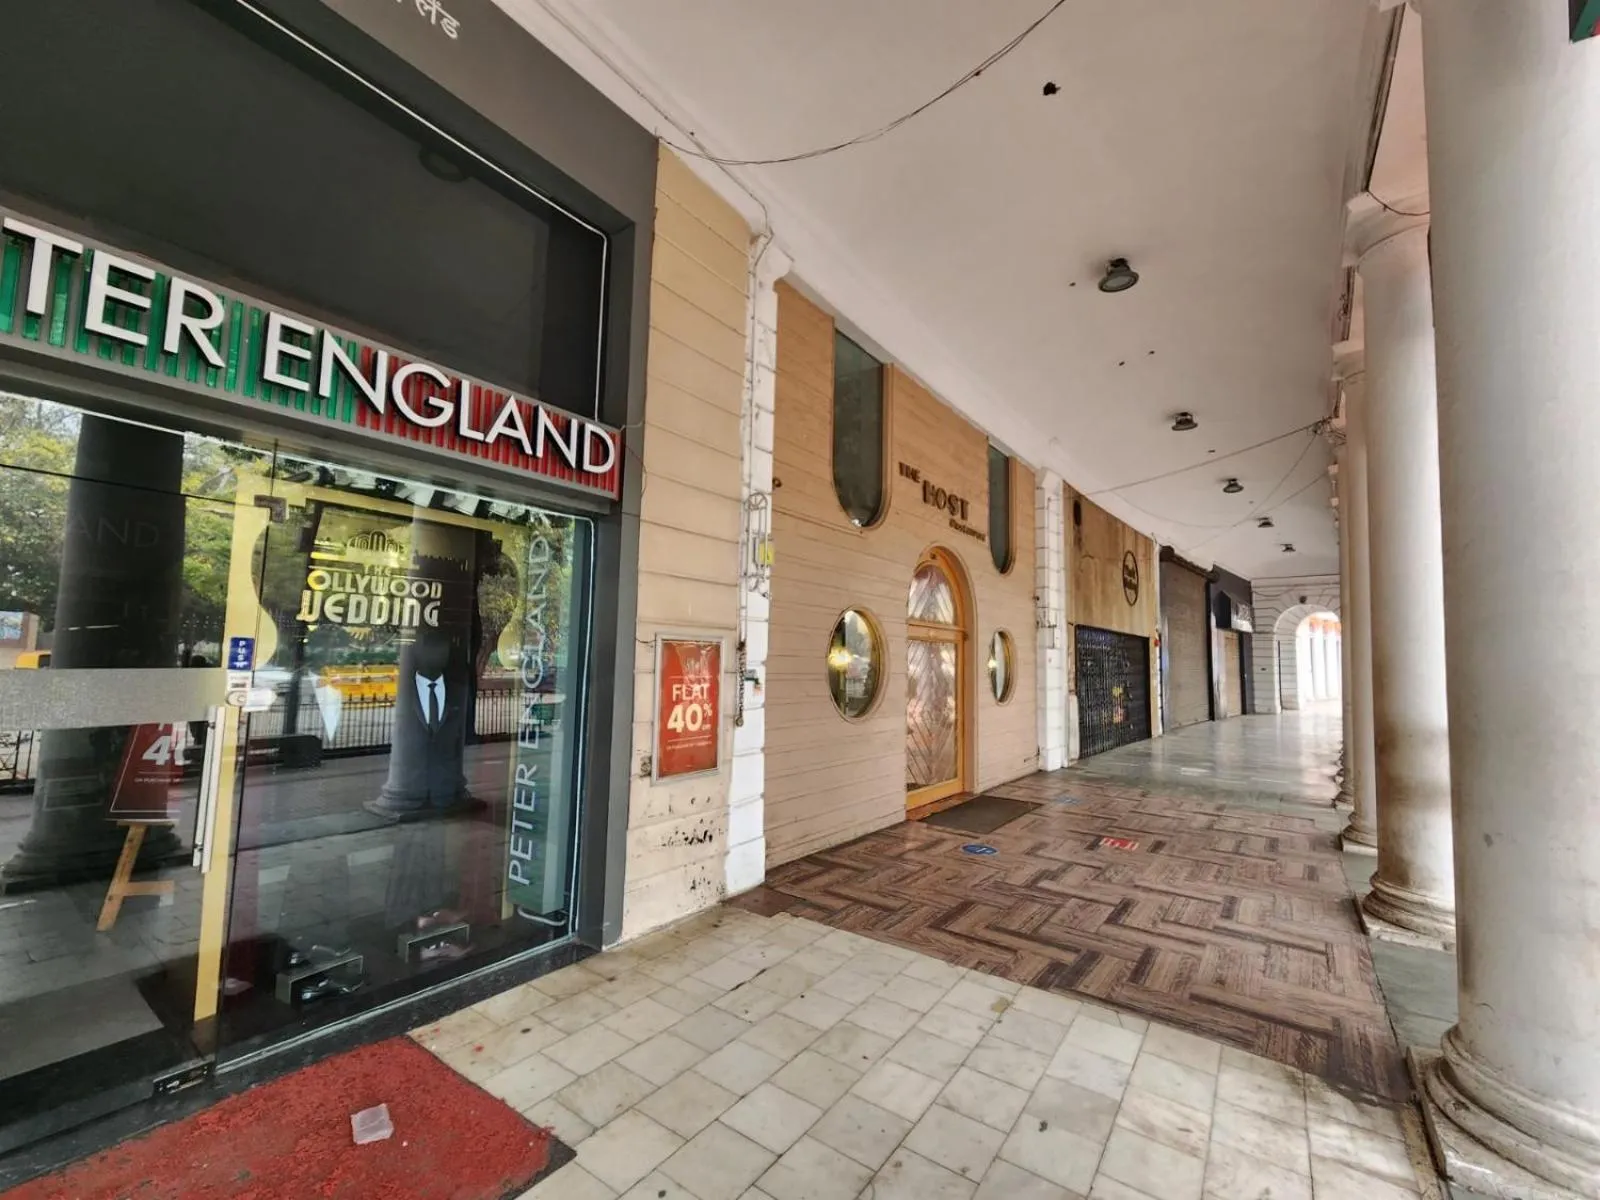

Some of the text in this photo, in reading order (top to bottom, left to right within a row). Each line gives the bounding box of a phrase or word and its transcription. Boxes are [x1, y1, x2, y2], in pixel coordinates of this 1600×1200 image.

[3, 217, 615, 474] TER ENGLAND
[922, 480, 969, 521] HOST
[296, 589, 441, 627] WEDDING
[508, 534, 551, 886] PETER ENGLAND
[672, 684, 710, 701] FLAT
